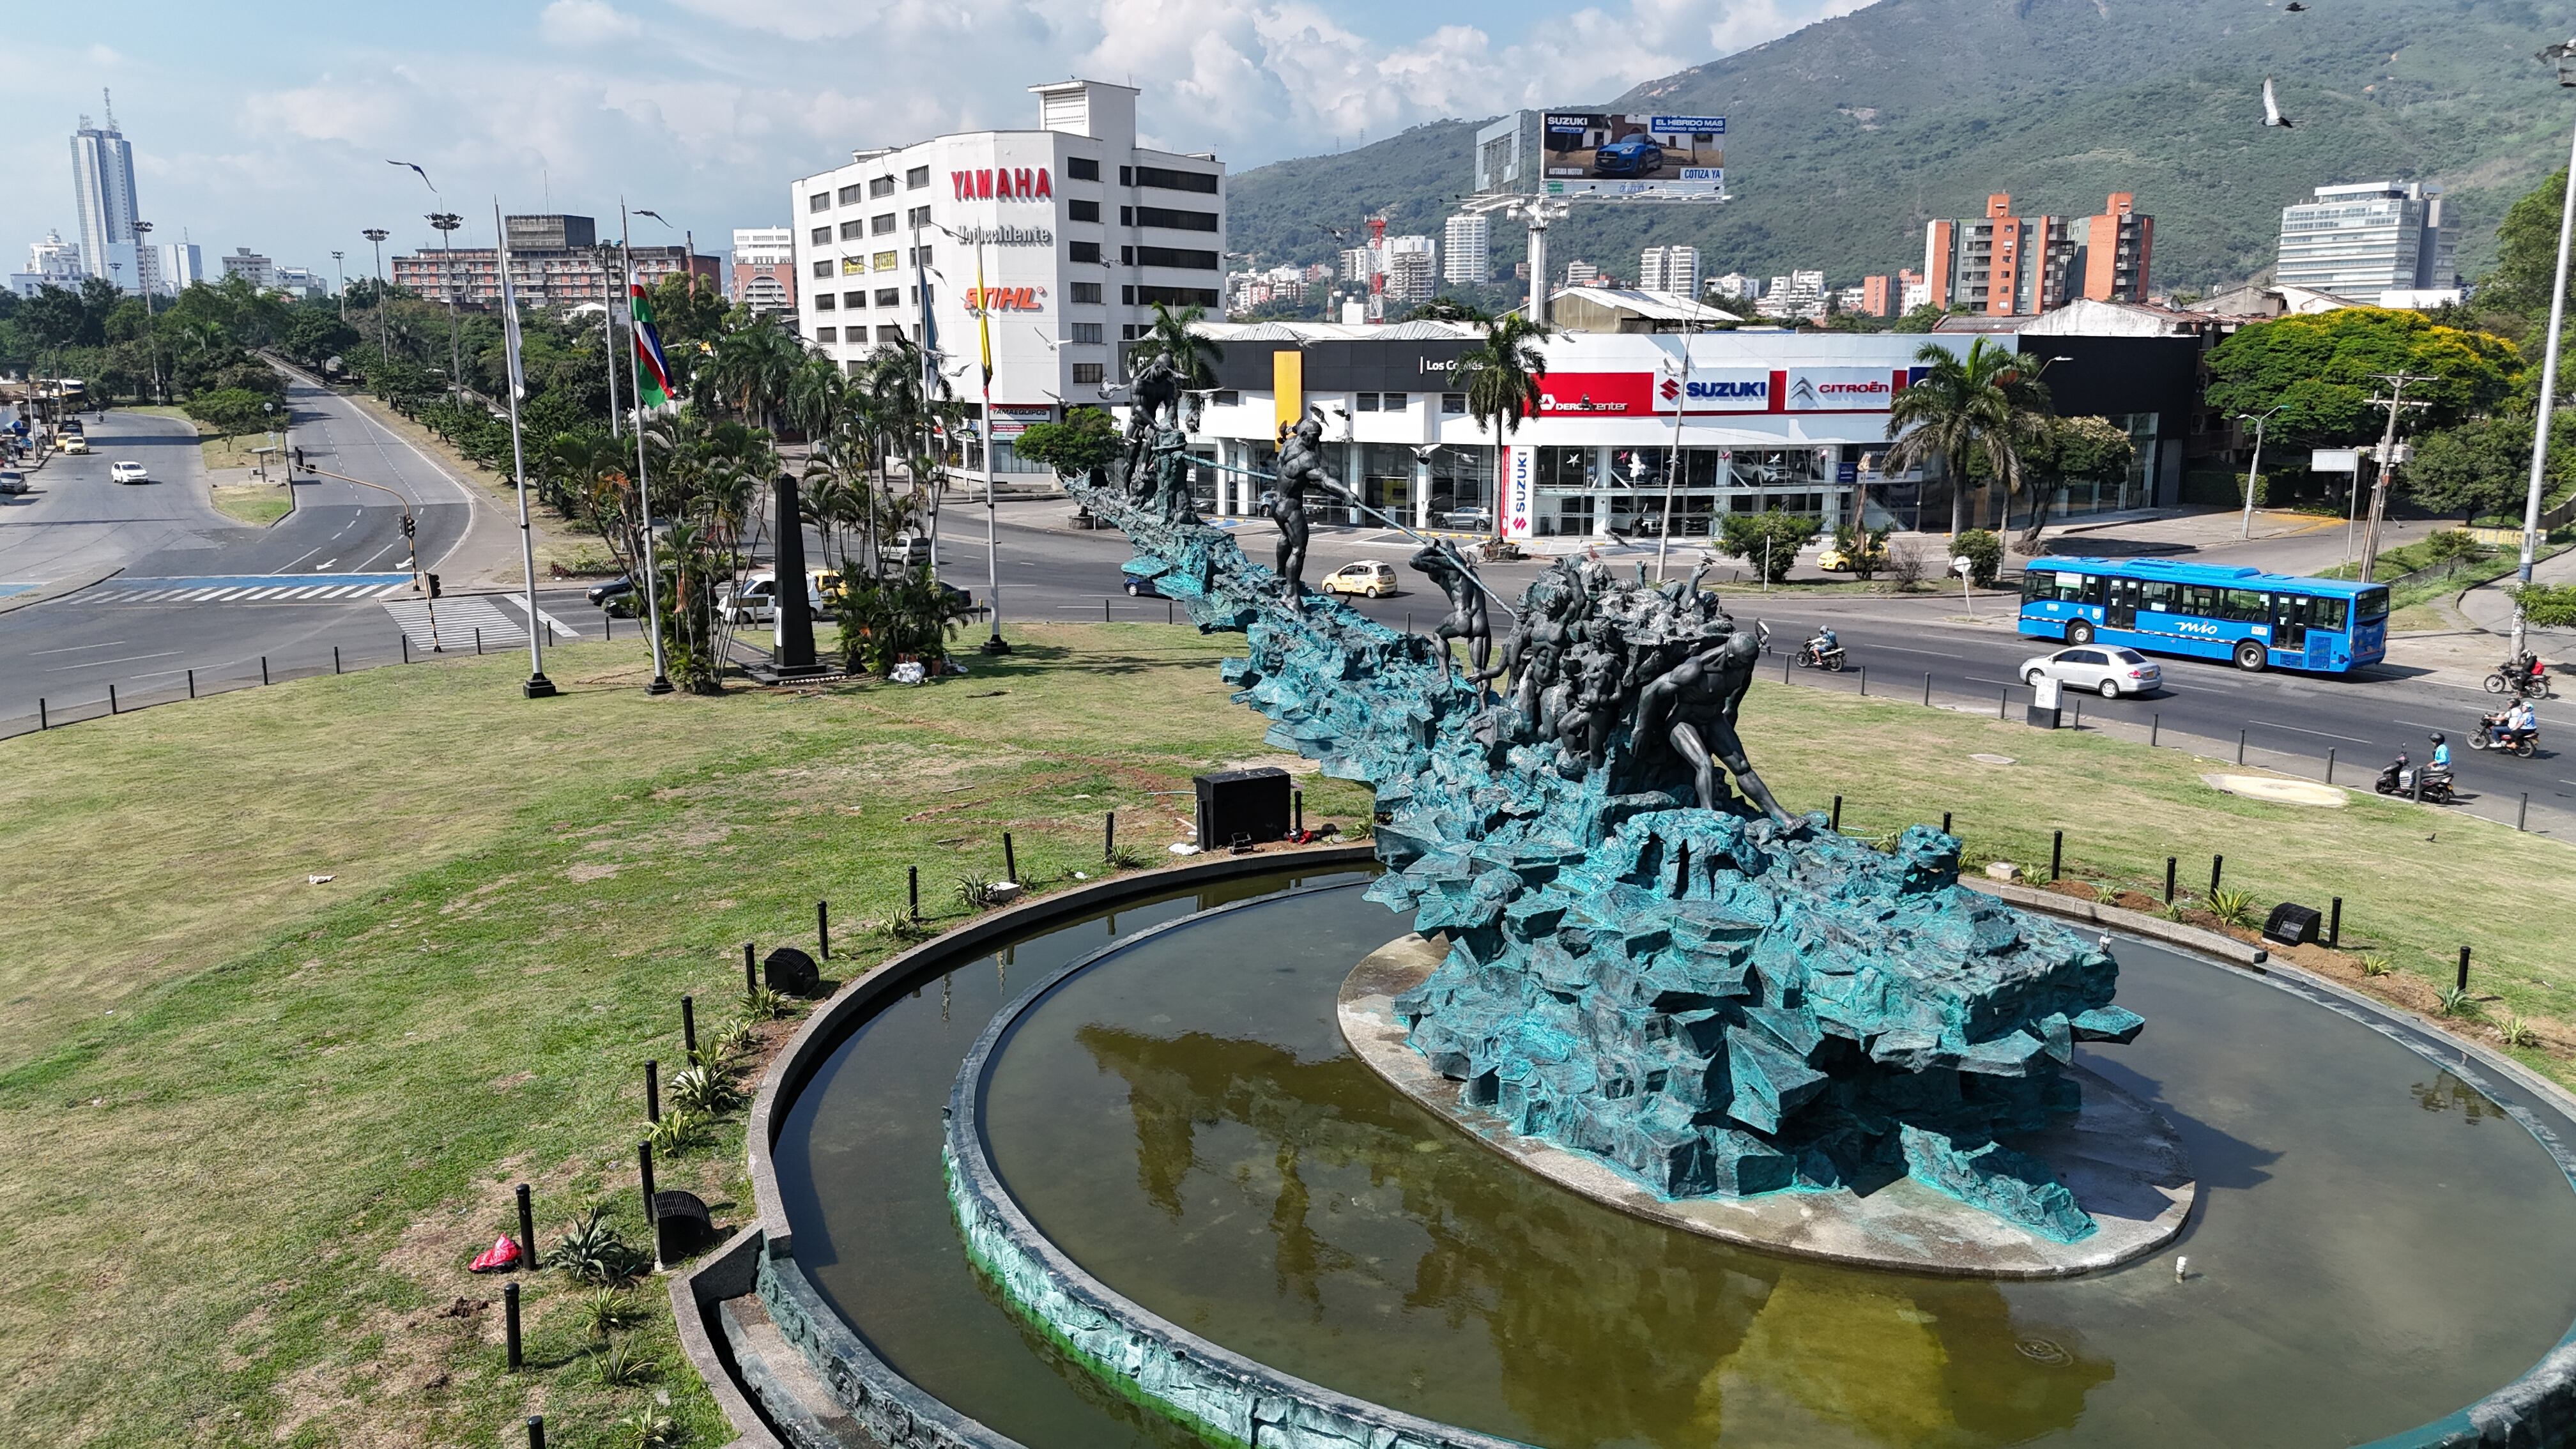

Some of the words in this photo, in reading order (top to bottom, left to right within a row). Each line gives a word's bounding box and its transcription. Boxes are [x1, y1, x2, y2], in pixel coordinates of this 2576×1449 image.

[1547, 116, 1588, 125] SUZUKI
[1704, 119, 1724, 127] MÁS
[1685, 169, 1709, 179] COTIZA
[1712, 169, 1721, 179] YA
[951, 168, 1052, 200] YAMAHA
[963, 287, 1041, 309] STIHL
[1426, 360, 1445, 371] Los
[1686, 381, 1767, 397] SUZUKI
[1515, 451, 1527, 513] SUZUKI
